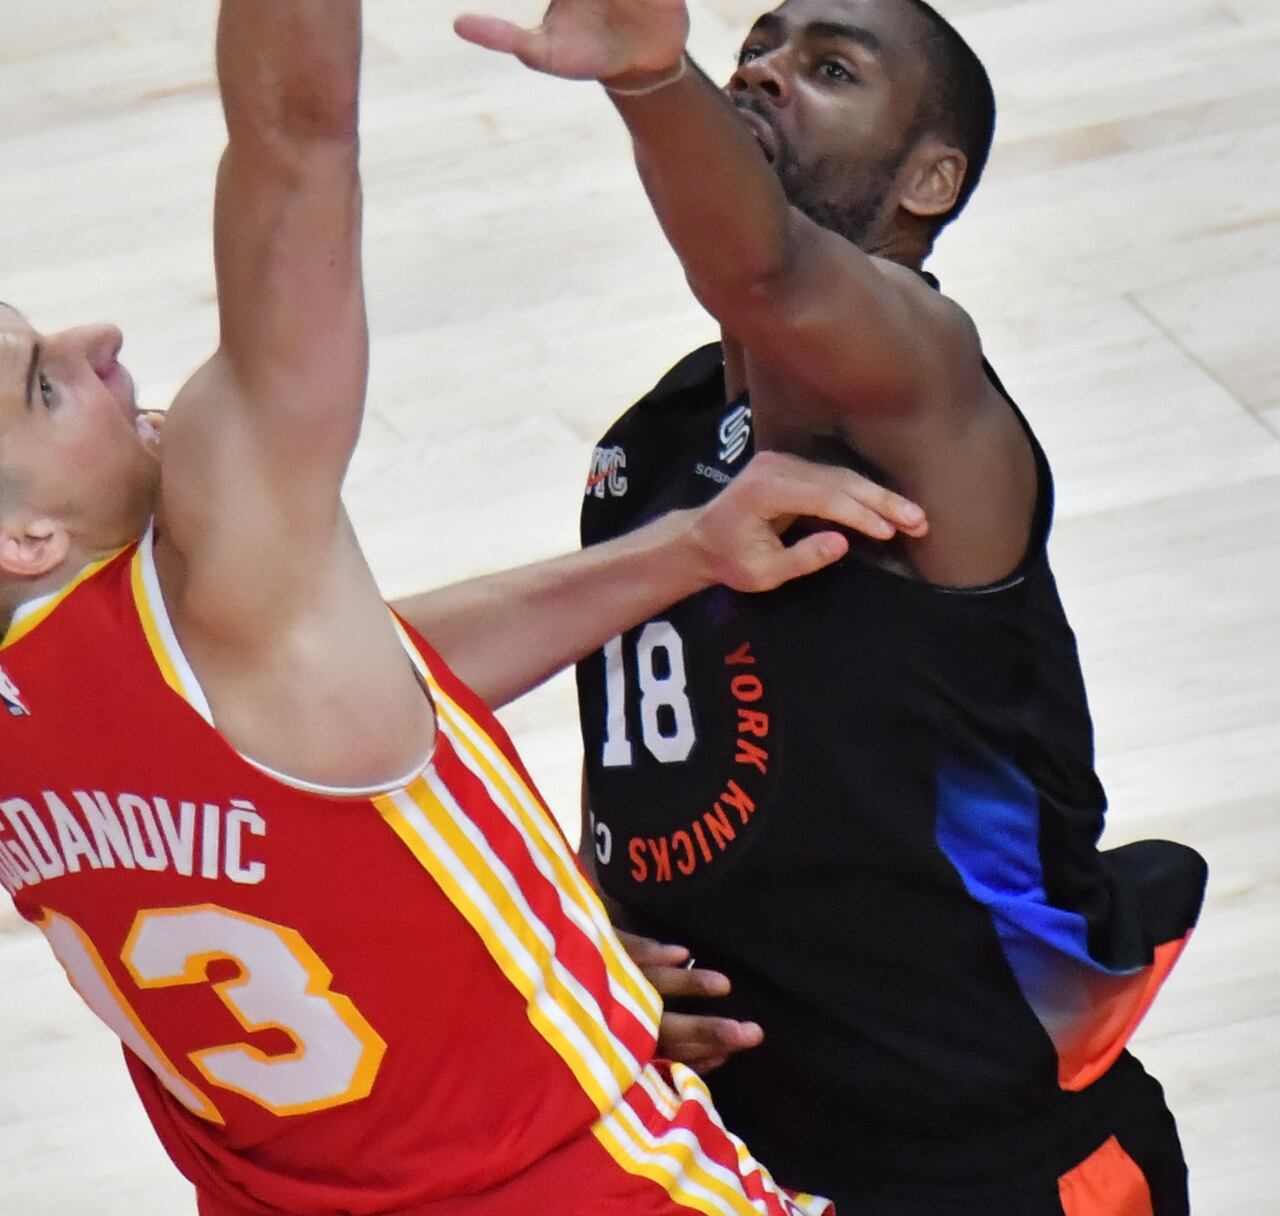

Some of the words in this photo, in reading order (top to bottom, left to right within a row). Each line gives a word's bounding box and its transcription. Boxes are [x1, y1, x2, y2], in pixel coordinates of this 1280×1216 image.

[602, 620, 700, 768] 18
[723, 640, 770, 775] YORK
[628, 778, 758, 884] KNICKS
[35, 902, 389, 1127] 13
